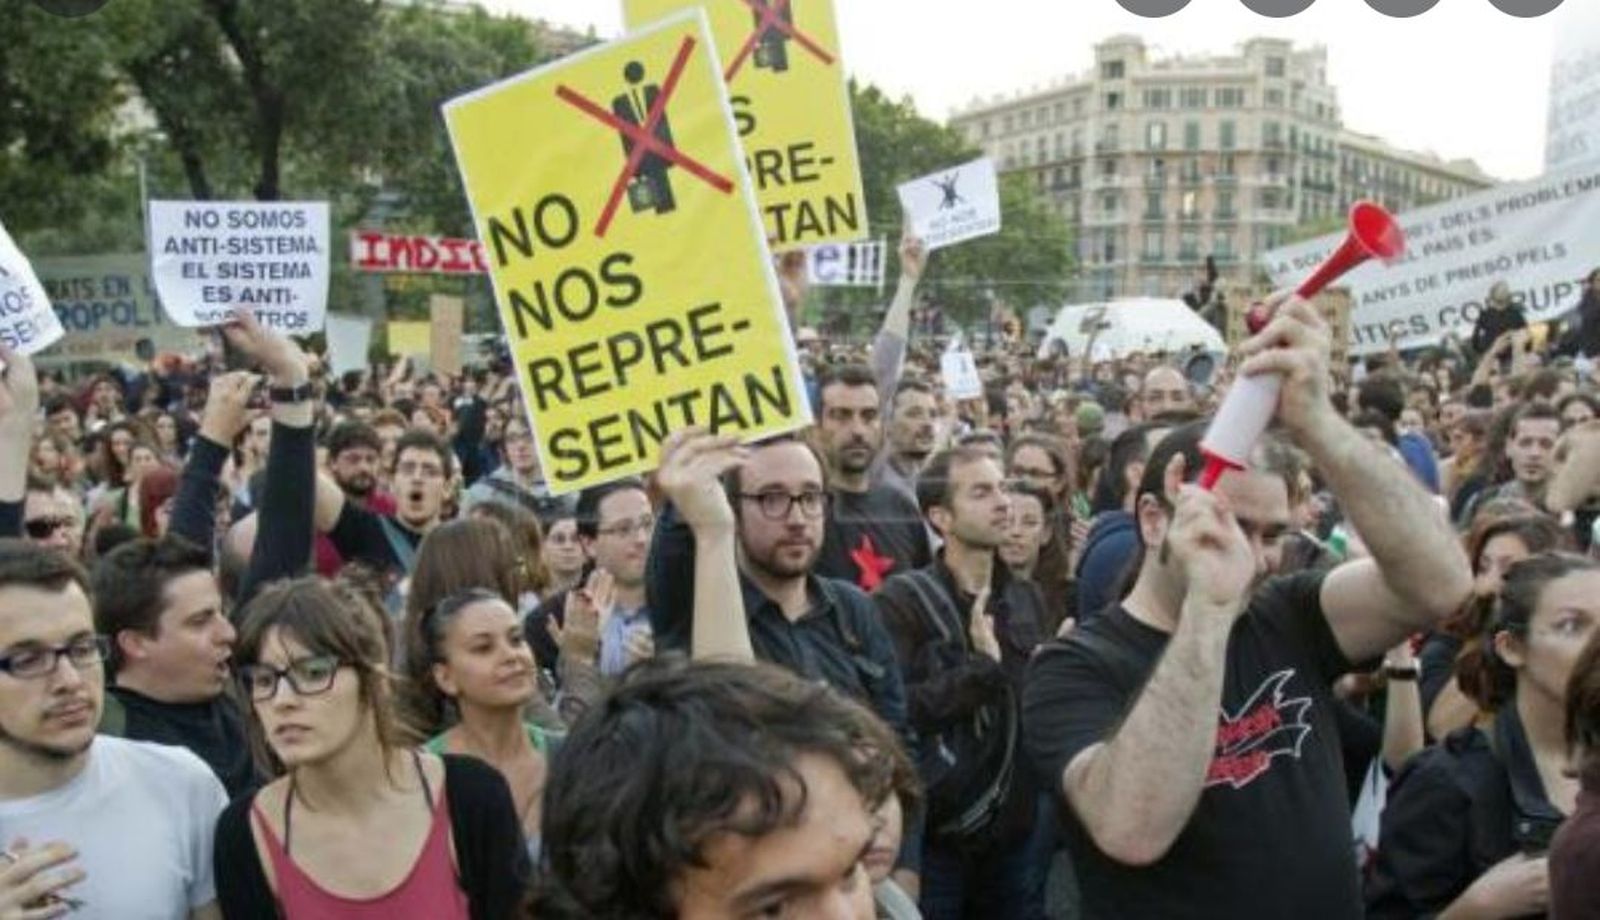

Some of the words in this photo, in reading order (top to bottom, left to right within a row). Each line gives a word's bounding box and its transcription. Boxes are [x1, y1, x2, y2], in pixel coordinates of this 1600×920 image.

[744, 142, 834, 190] RE-
[184, 210, 220, 229] NO
[227, 210, 307, 229] SOMOS
[488, 193, 578, 267] NO
[1440, 206, 1491, 230] DELS
[182, 262, 209, 279] EL
[217, 262, 312, 279] SISTEMA
[202, 285, 232, 303] ES
[239, 286, 299, 304] ANTI-
[508, 252, 643, 339] NOS
[1361, 281, 1411, 304] ANYS
[1414, 274, 1439, 293] DE
[1516, 243, 1567, 266] PELS
[528, 302, 750, 411] REPRE-
[547, 366, 792, 481] SENTAN
